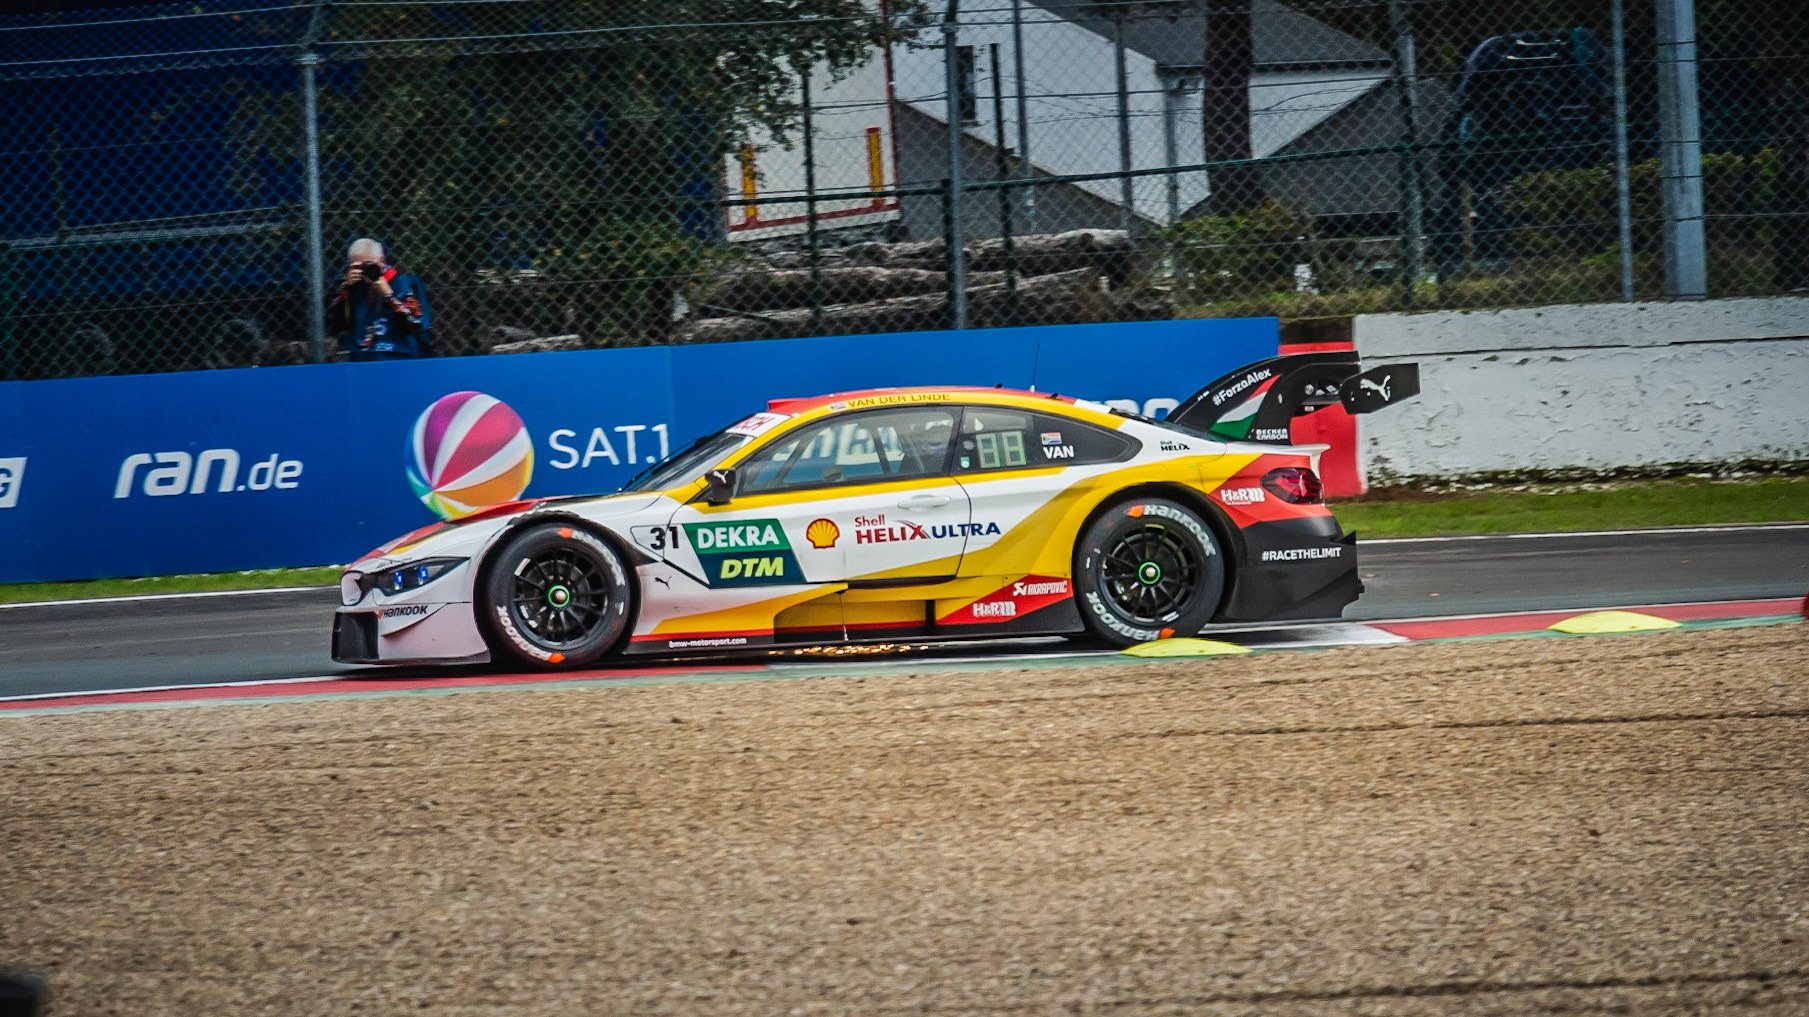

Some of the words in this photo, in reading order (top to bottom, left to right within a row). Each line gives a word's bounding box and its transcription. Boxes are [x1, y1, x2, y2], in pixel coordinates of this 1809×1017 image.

[1212, 368, 1272, 406] #ForzaAlex
[847, 398, 875, 408] VAN
[879, 395, 906, 404] DER
[910, 393, 951, 401] LINDE
[549, 423, 671, 470] SAT.1
[1043, 445, 1074, 459] VAN
[1161, 443, 1190, 451] HELIX
[113, 448, 304, 499] ran.de
[854, 514, 886, 527] Shell
[650, 526, 679, 550] 31
[697, 524, 780, 549] DEKRA
[855, 521, 931, 545] HELIX
[931, 522, 1001, 539] ULTRA
[1261, 547, 1342, 562] #RACETHELIMIT
[720, 556, 784, 579] DTM
[668, 637, 747, 648] bmw-motorsport.com
